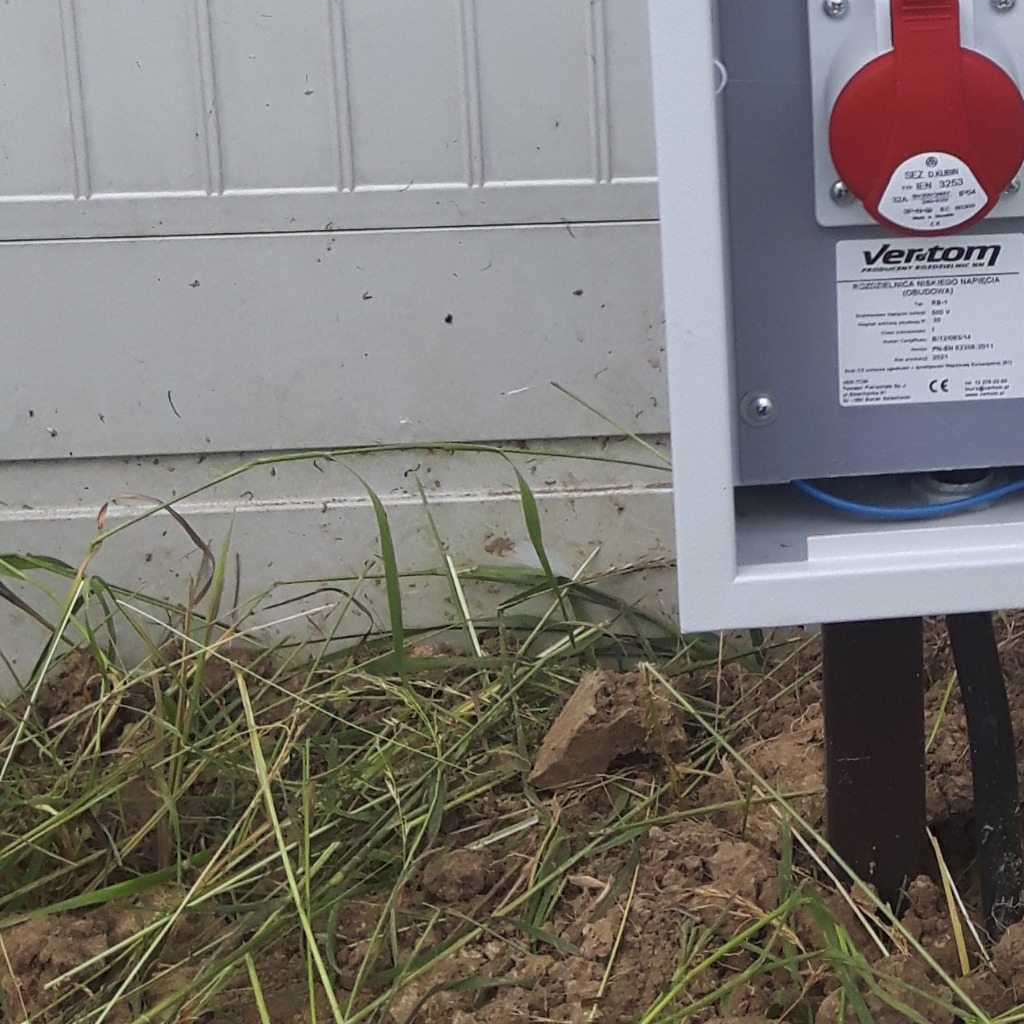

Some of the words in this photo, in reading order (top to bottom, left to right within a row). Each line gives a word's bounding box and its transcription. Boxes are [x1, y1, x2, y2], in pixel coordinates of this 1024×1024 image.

[905, 171, 923, 179] SEZ
[916, 182, 932, 190] IEN
[939, 178, 964, 188] 3253
[861, 265, 913, 273] PRODUCENT
[852, 281, 915, 290] ROZDZIELNICA
[917, 278, 958, 287] NISKIEGO
[961, 276, 1000, 285] NAPIĘCIA
[902, 287, 954, 297] (OBUDOWA)
